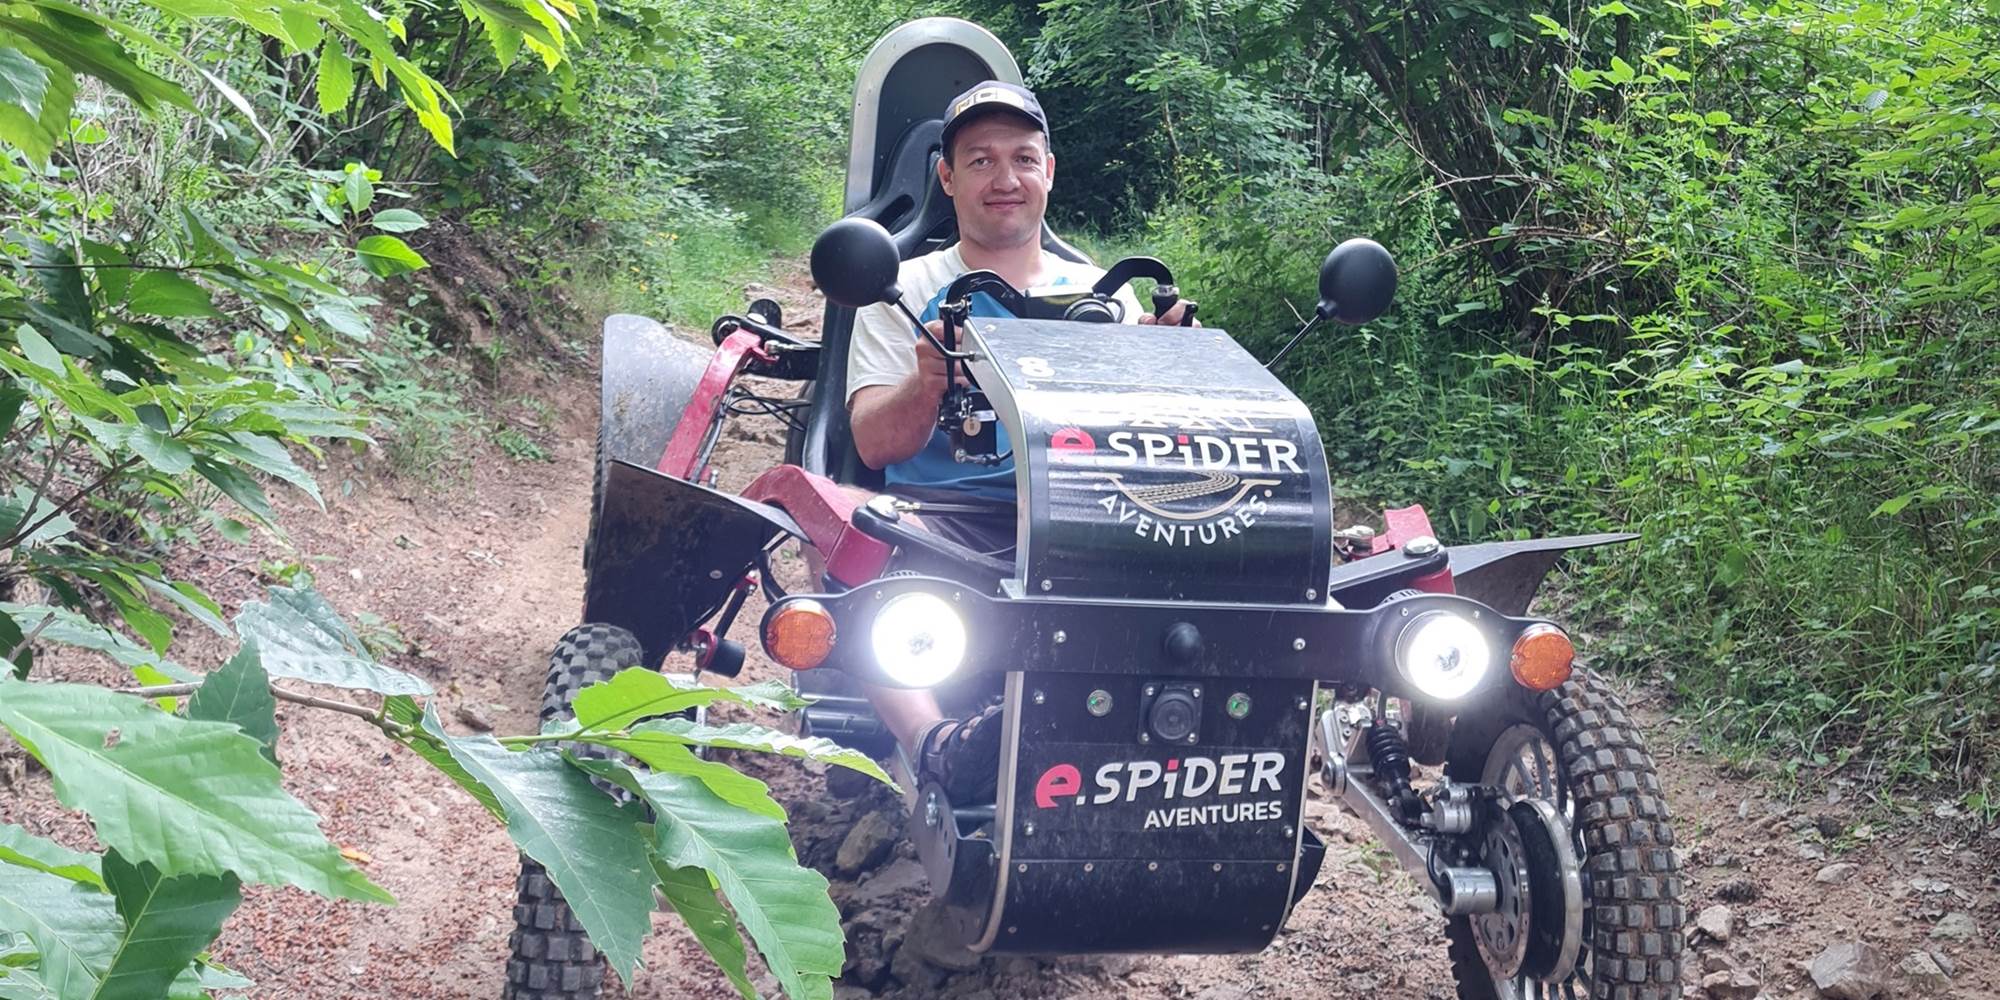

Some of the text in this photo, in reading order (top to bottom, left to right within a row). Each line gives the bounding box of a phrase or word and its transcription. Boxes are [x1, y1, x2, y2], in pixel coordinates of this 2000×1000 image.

[1017, 357, 1055, 378] 8
[1098, 494, 1268, 546] AVENTURES
[1144, 801, 1283, 829] AVENTURES
